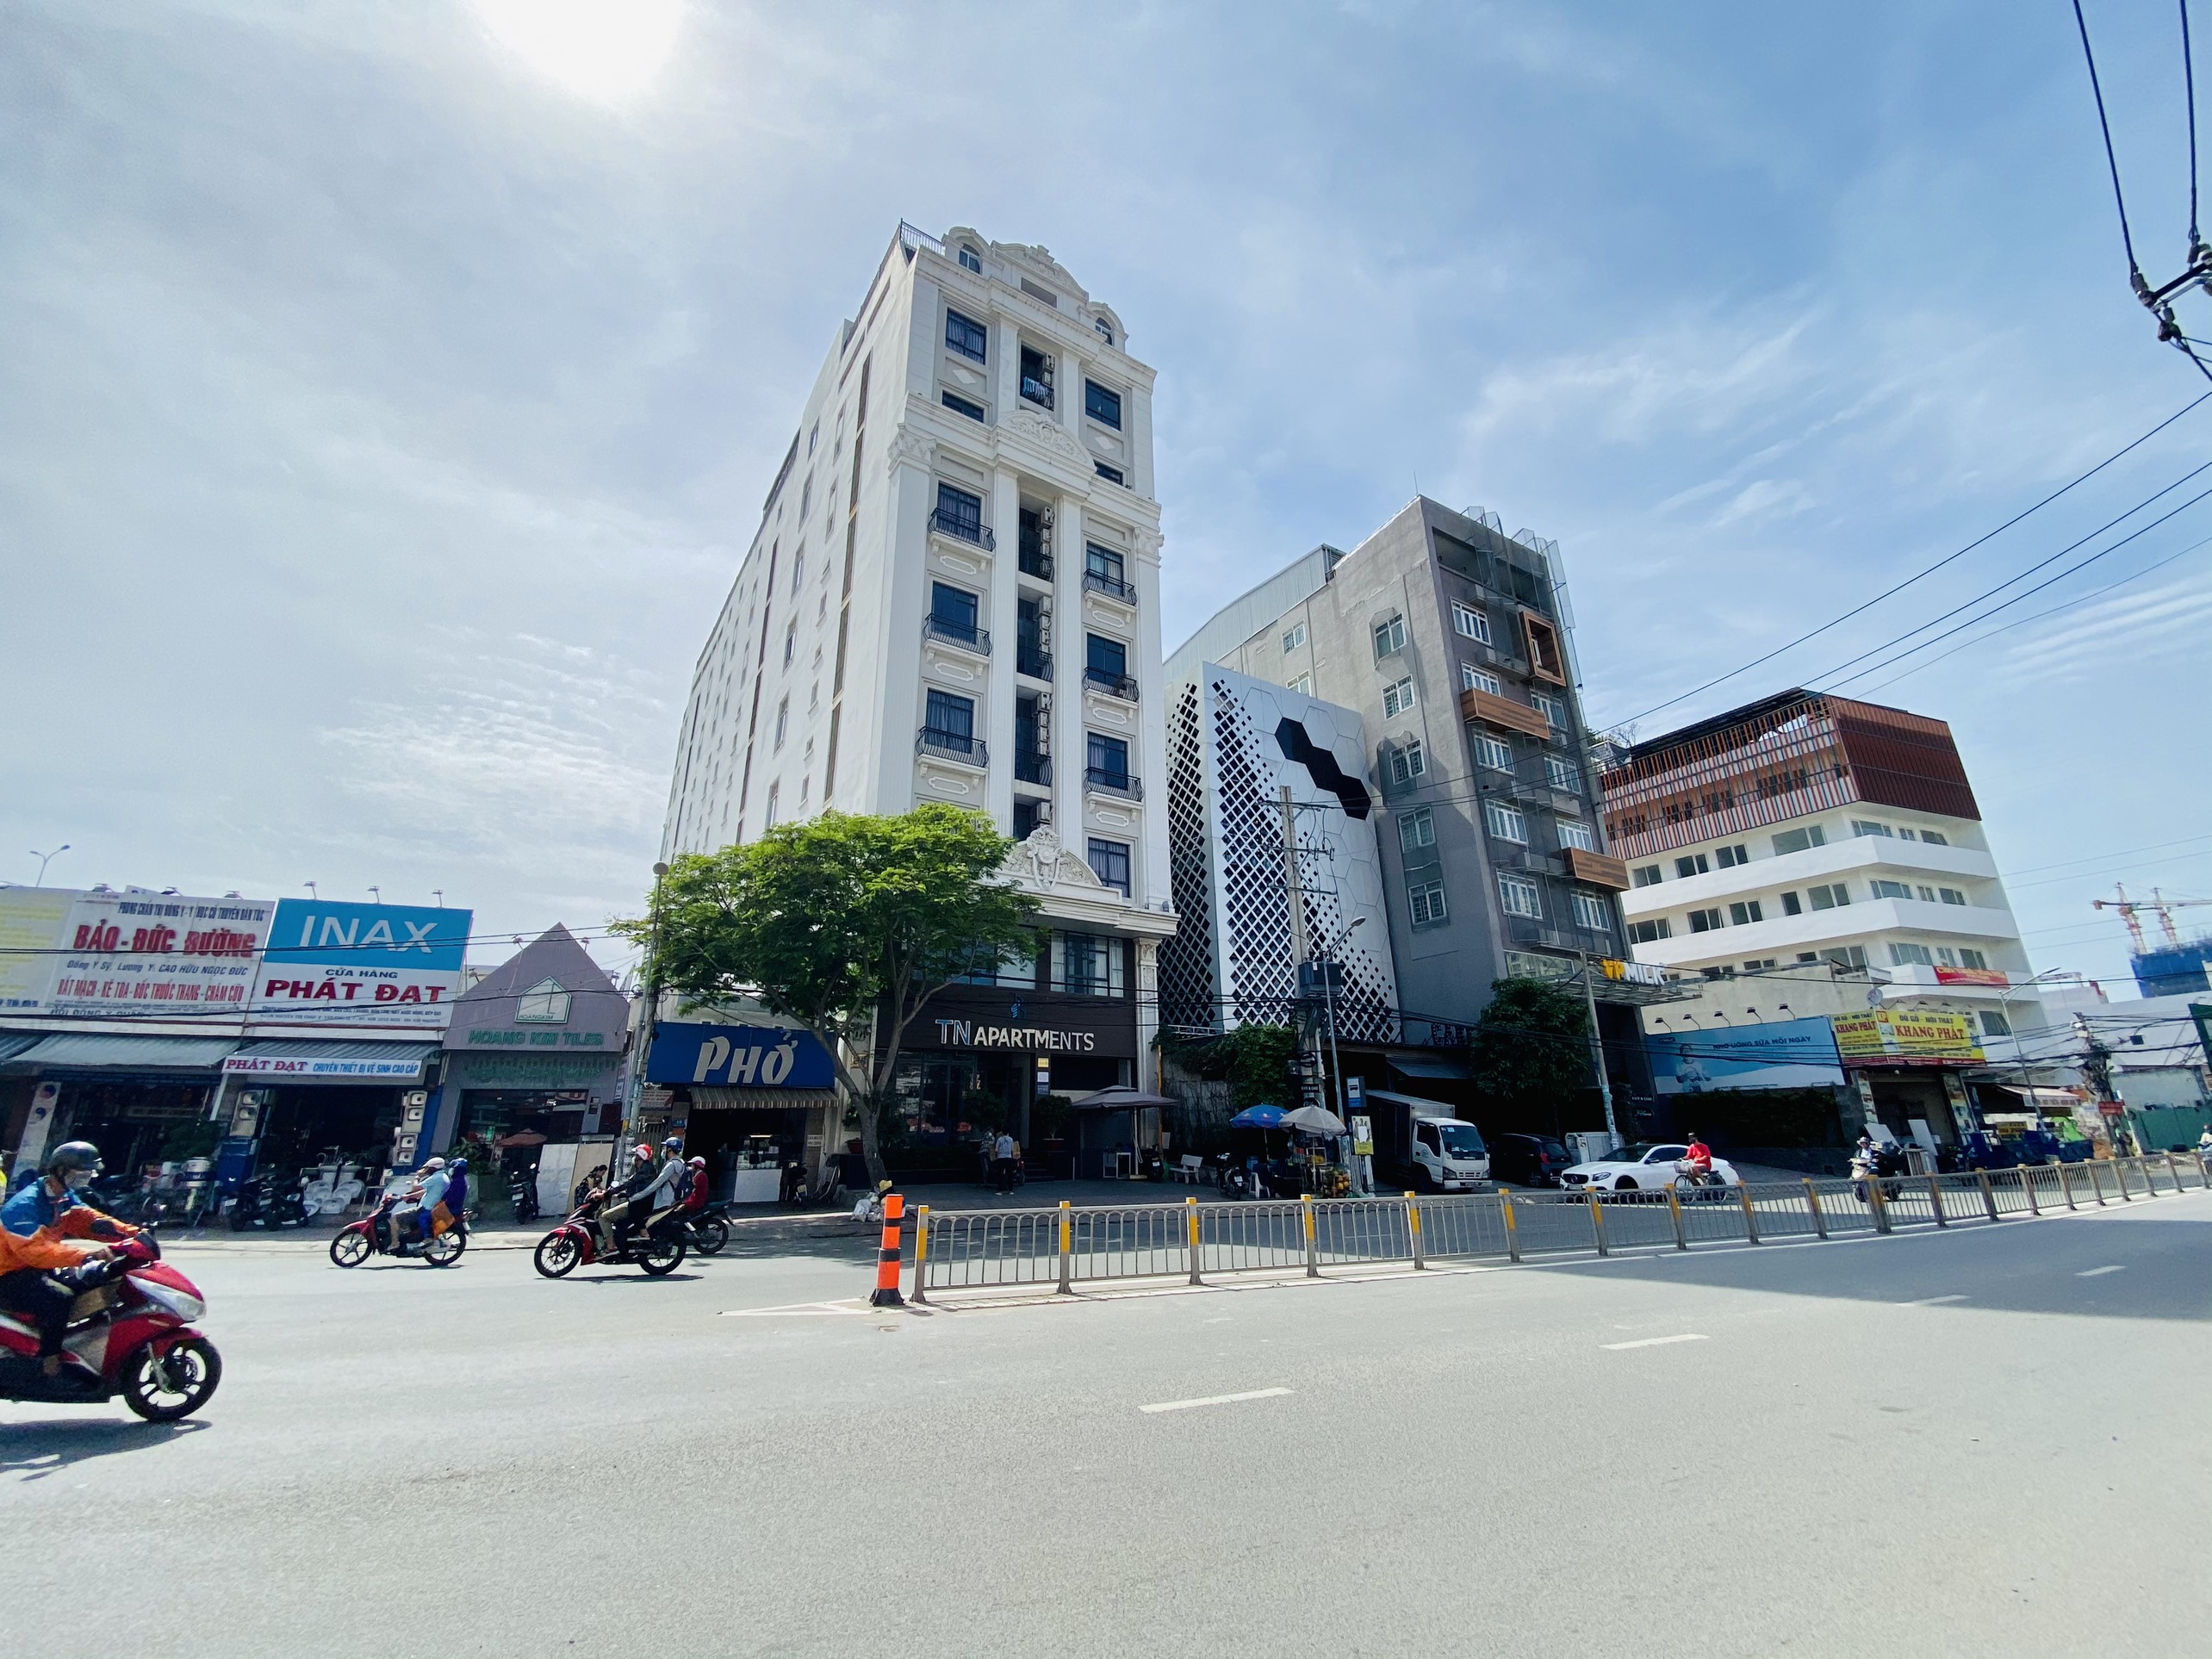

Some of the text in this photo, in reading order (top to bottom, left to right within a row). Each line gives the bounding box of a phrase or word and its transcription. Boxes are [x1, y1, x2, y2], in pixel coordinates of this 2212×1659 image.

[73, 918, 120, 951] BẢO
[132, 923, 177, 951] ĐỨC
[183, 928, 257, 958] ĐƯỜNG
[299, 915, 438, 954] INAX
[91, 961, 99, 970] Y
[158, 965, 177, 973] CAO
[201, 966, 227, 977] NGỌC
[228, 966, 248, 976] ĐỨC
[325, 967, 398, 979] CỬA HÀNG
[176, 984, 202, 1001] THANG
[264, 978, 446, 1005] PHÁT ĐẠT
[935, 1019, 1095, 1051] TN APARTMENTS
[1835, 1020, 1877, 1034] KHANG PHÁT
[1895, 1023, 1964, 1040] KHANG PHÁT
[468, 1030, 605, 1047] HOANG KIM TILES
[1789, 1035, 1811, 1044] NGÀY
[693, 1029, 798, 1084] PHỞ
[226, 1057, 270, 1071] PHÁT
[273, 1060, 308, 1073] ĐẠT
[313, 1060, 339, 1072] CHUYÊN
[339, 1060, 358, 1073] THIẾT
[376, 1063, 391, 1073] SINH
[391, 1064, 405, 1073] CAO
[405, 1061, 419, 1074] CẤP
